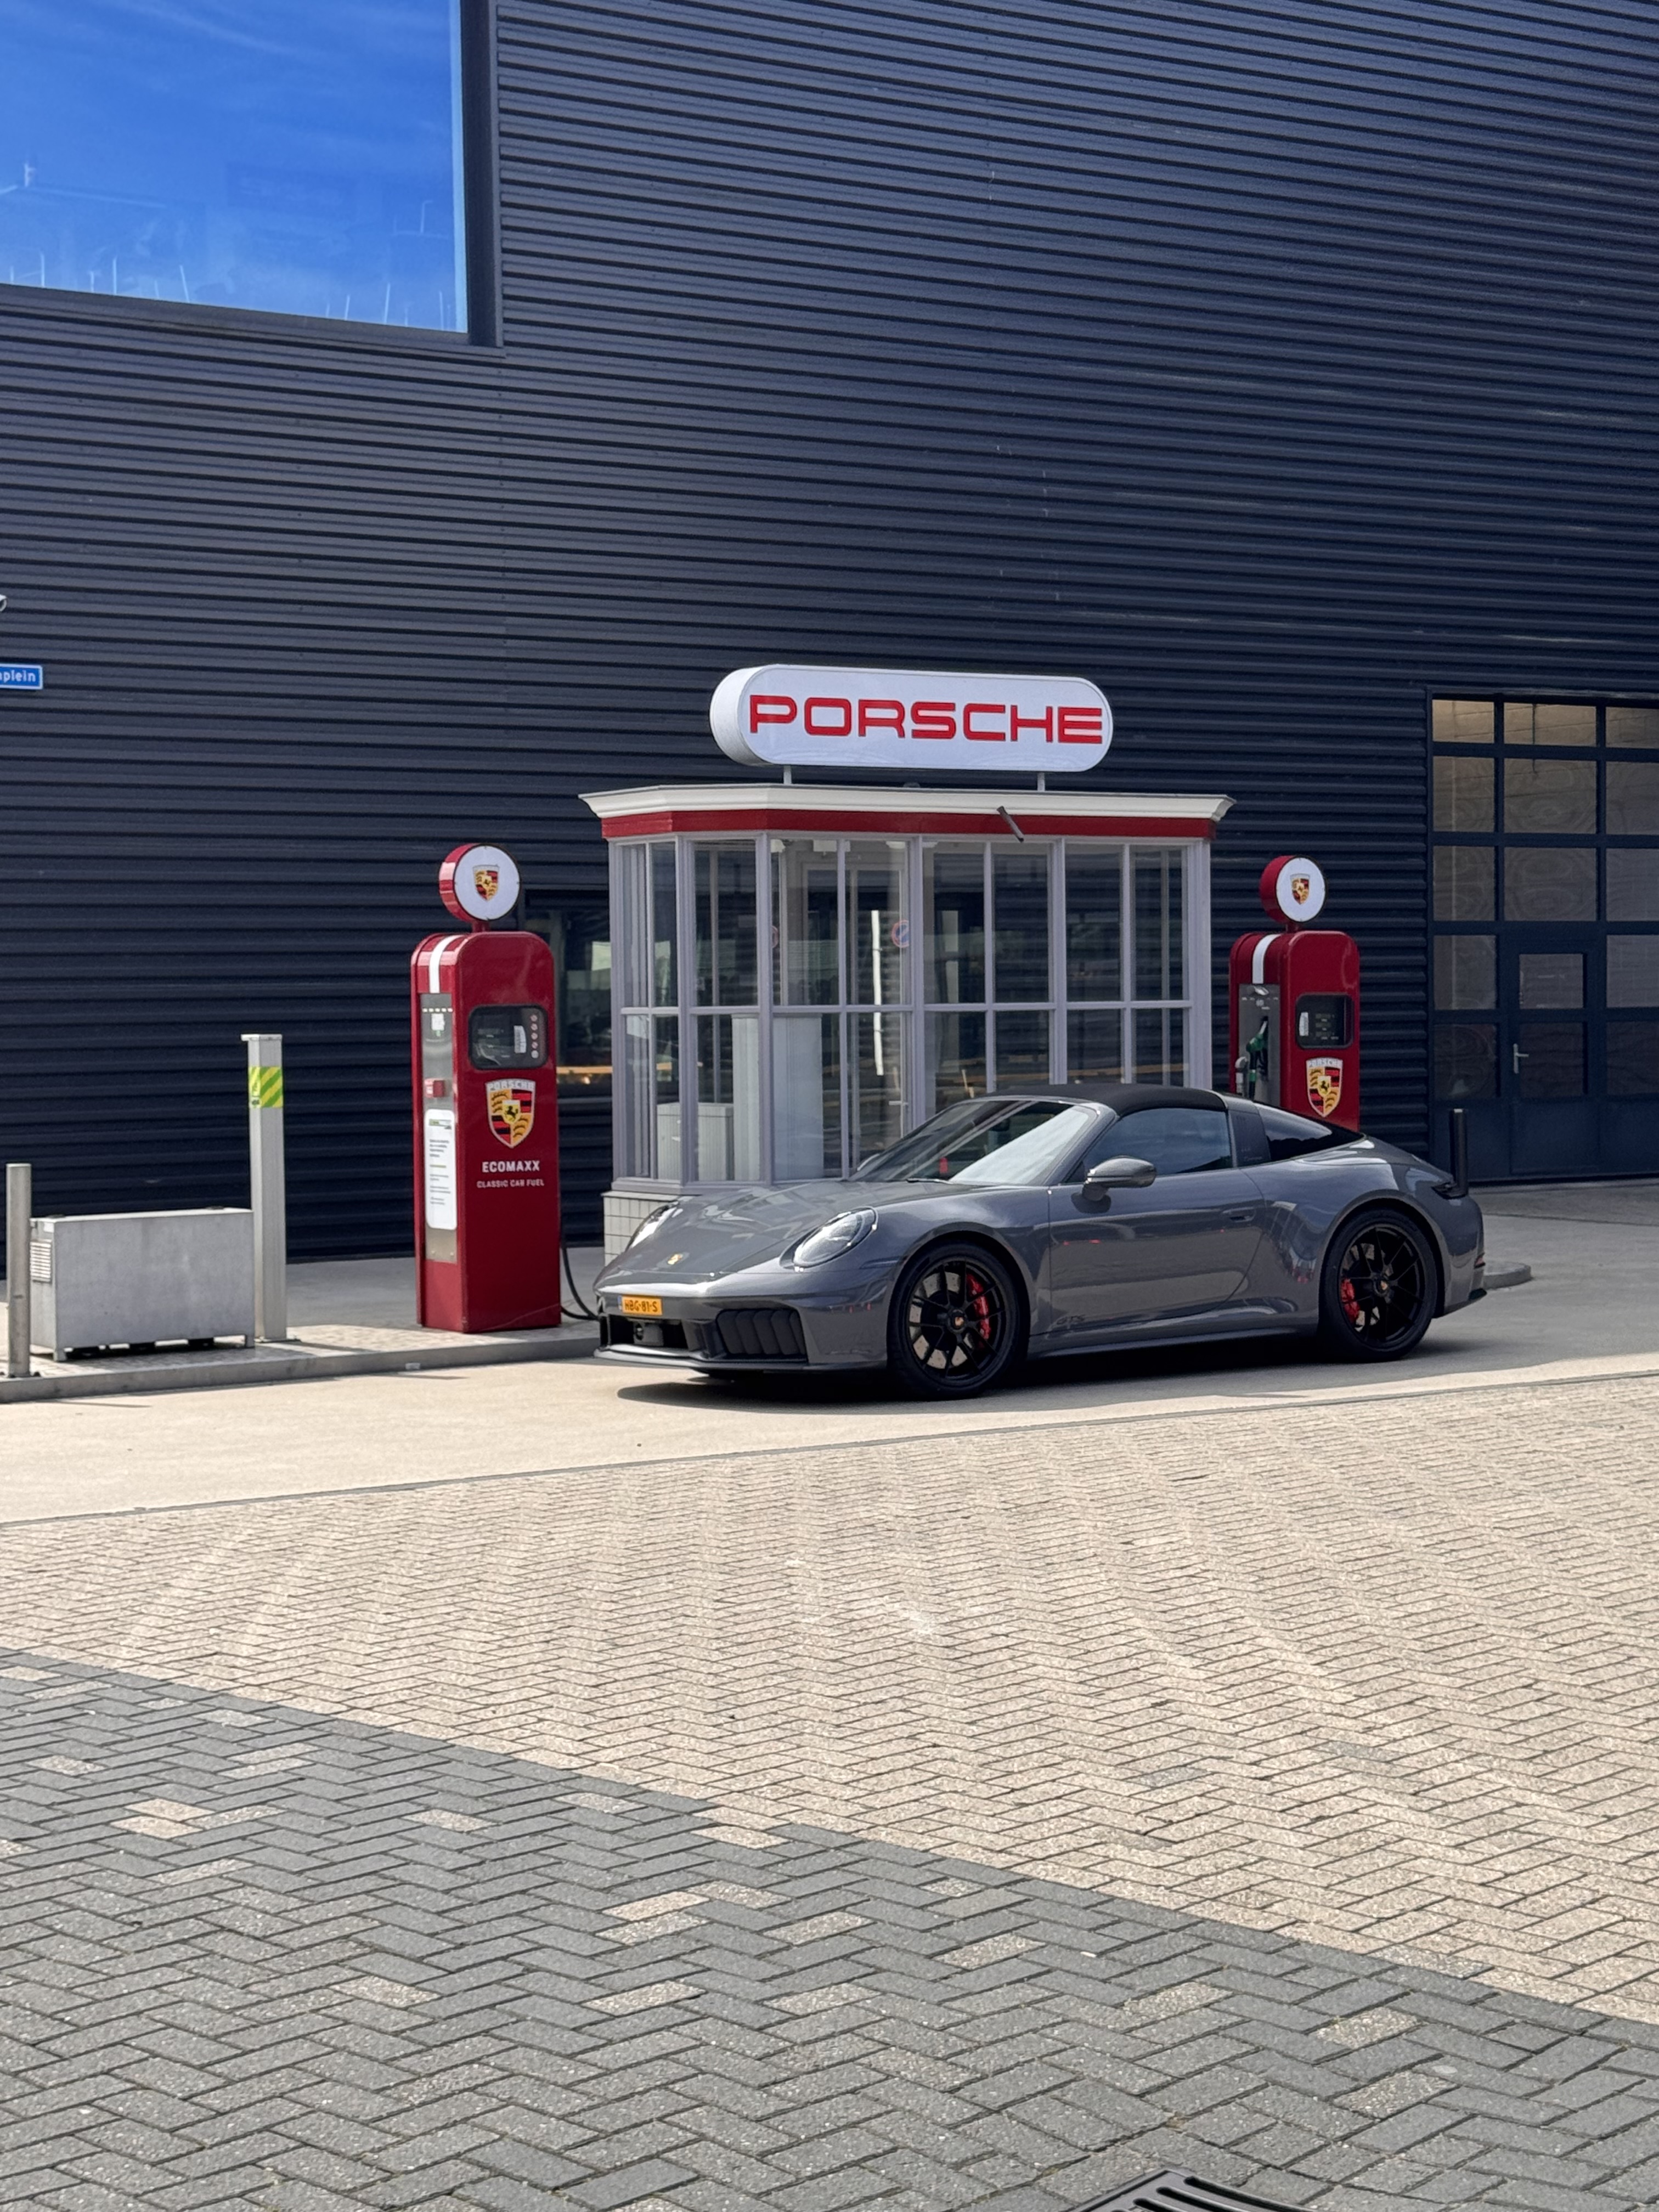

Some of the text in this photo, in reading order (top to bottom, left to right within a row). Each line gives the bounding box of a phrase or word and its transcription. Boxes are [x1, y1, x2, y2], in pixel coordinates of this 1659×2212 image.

[0, 669, 36, 683] plein
[749, 695, 1103, 744] PORSCHE
[482, 1160, 540, 1173] ECOMAXX
[476, 1178, 545, 1188] CLASSIC CAR FUEL
